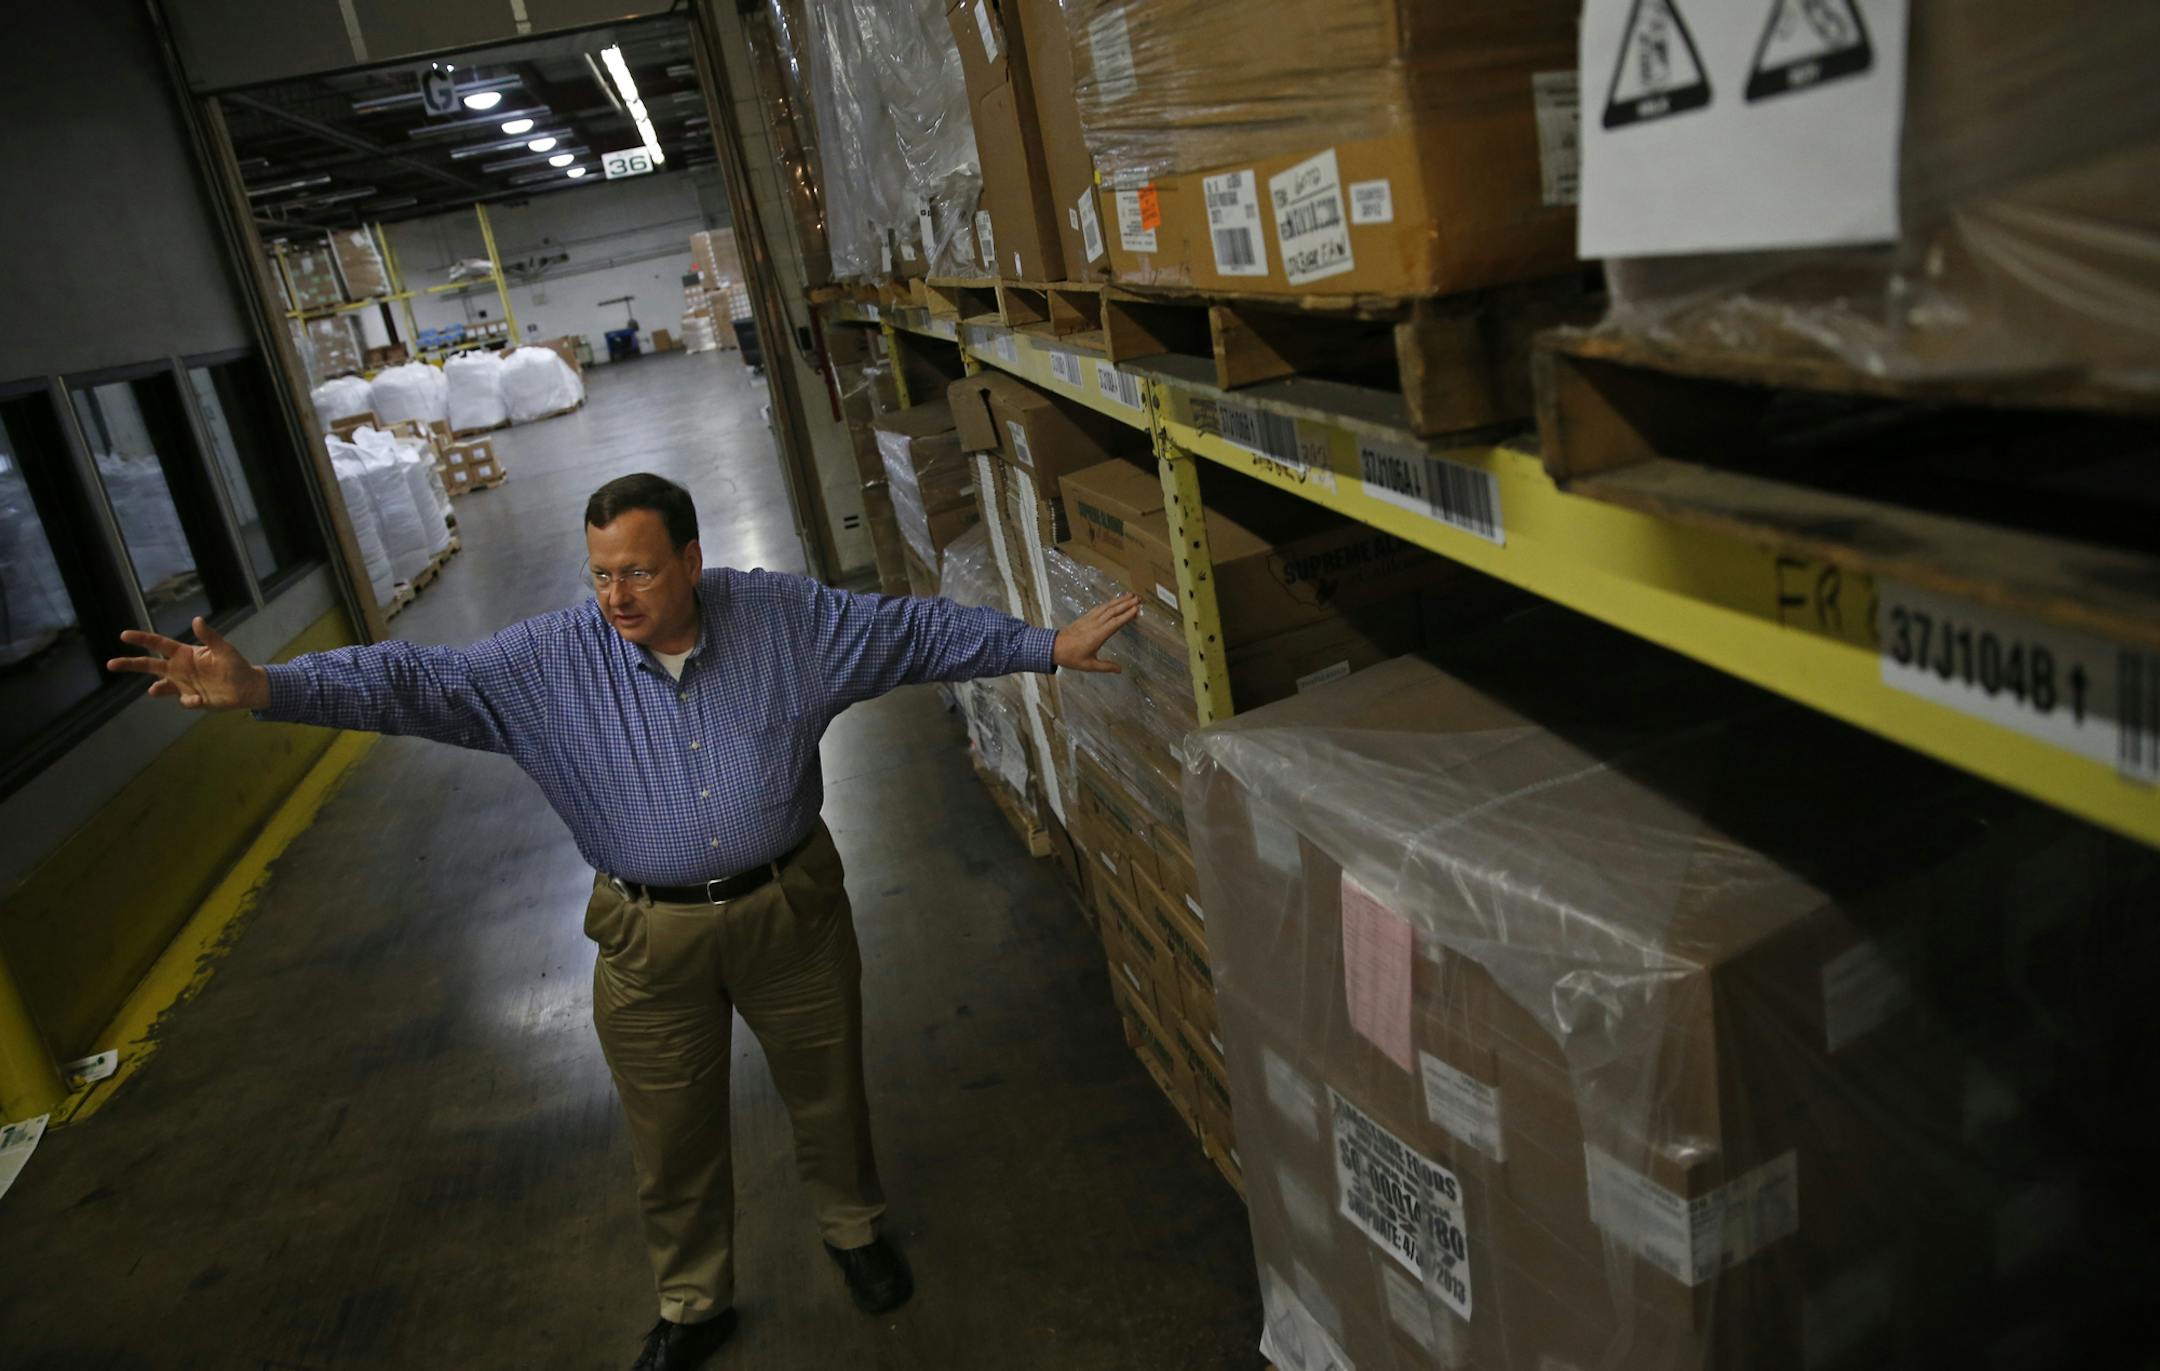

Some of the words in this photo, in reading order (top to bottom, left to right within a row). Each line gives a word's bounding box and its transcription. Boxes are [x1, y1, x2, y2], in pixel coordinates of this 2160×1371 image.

[422, 69, 453, 111] G
[609, 156, 648, 176] 36
[1361, 448, 1414, 497] 37J106A
[1283, 540, 1372, 585] SUPREME
[1889, 604, 2056, 713] 37J104B
[1405, 1148, 1457, 1202] FOODS
